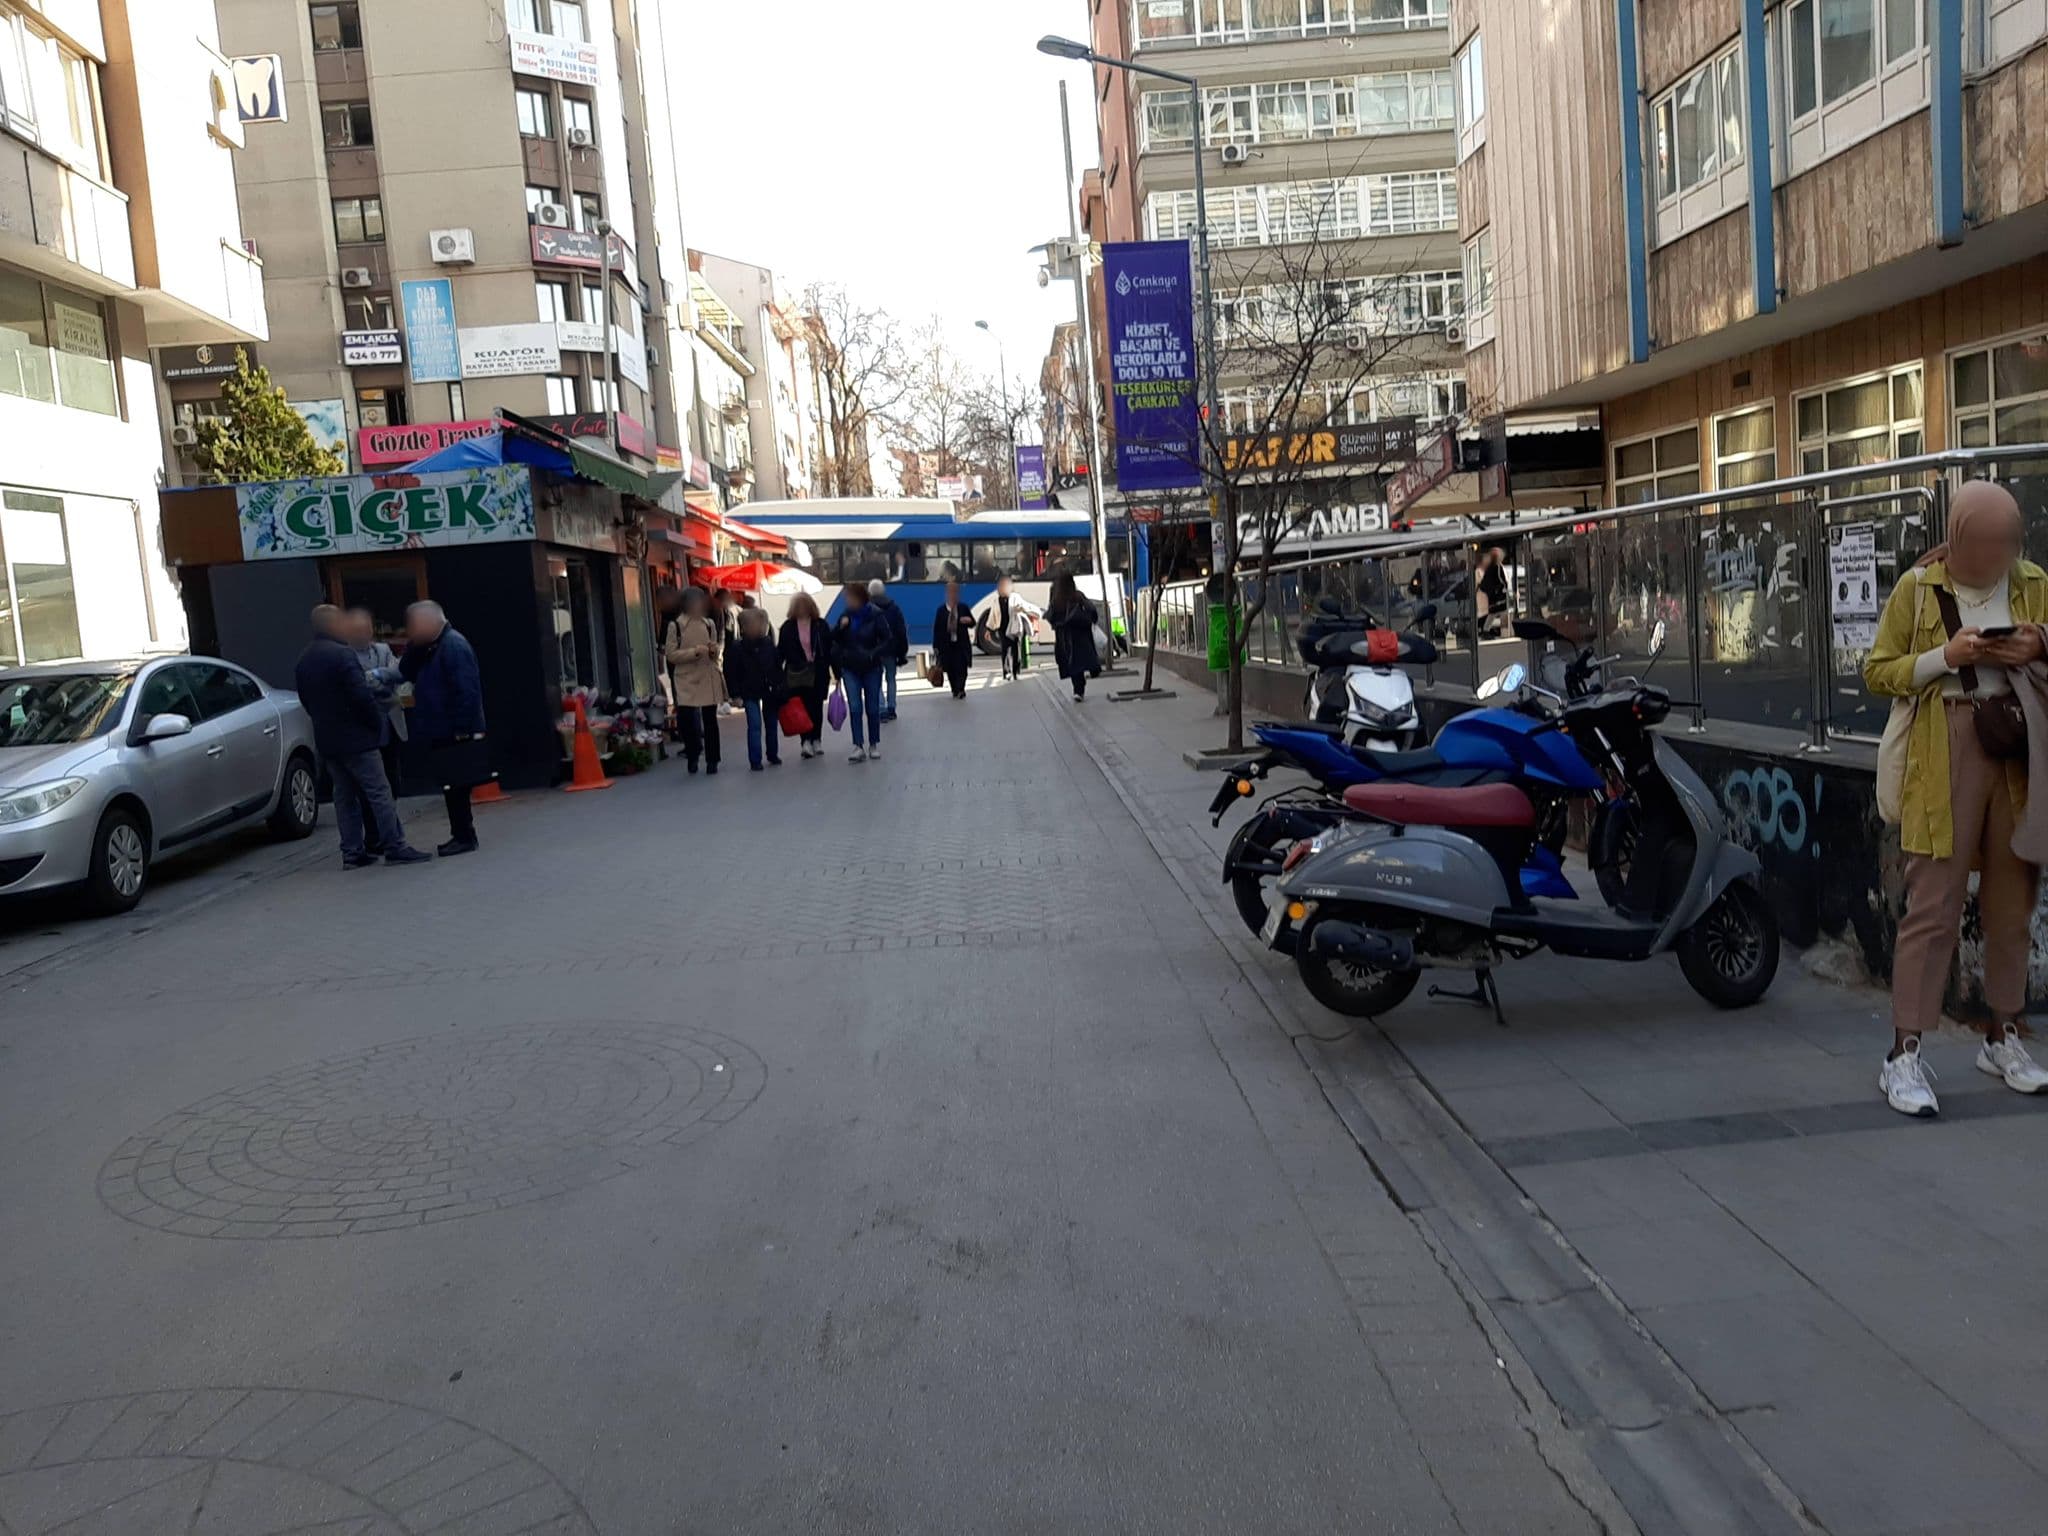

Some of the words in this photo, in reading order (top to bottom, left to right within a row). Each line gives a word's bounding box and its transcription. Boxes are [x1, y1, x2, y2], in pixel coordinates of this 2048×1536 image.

[1133, 275, 1178, 289] Çankaya
[1125, 321, 1173, 338] HİZMET,
[345, 334, 398, 345] EMLAKSA
[1119, 339, 1163, 355] BAŞARI
[1164, 337, 1181, 351] VE
[349, 351, 367, 360] 424
[379, 350, 398, 358] 777
[474, 347, 546, 359] KUAFÖR
[1113, 351, 1187, 368] REKORLARLA
[1119, 367, 1149, 380] DOLU
[1166, 364, 1185, 378] YIL
[1126, 395, 1181, 413] ÇANKAYA
[370, 430, 432, 454] Gözde
[1224, 431, 1336, 471] UAFÖR
[285, 485, 498, 550] ÇİÇEK
